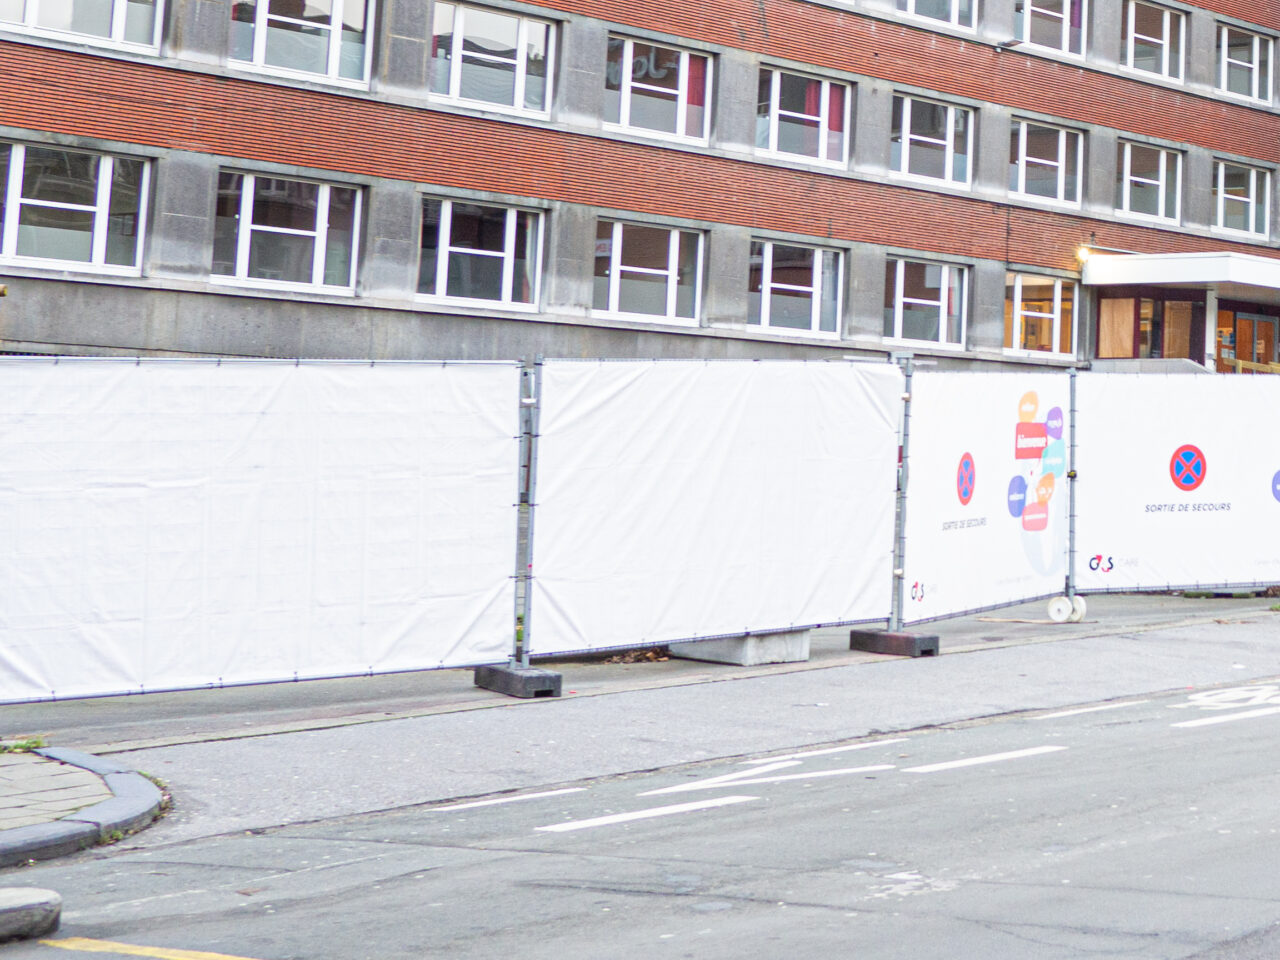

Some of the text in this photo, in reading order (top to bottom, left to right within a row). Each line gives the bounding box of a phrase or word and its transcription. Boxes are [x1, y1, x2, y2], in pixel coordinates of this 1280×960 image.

[1145, 502, 1232, 513] SORTIE DE SECOURS
